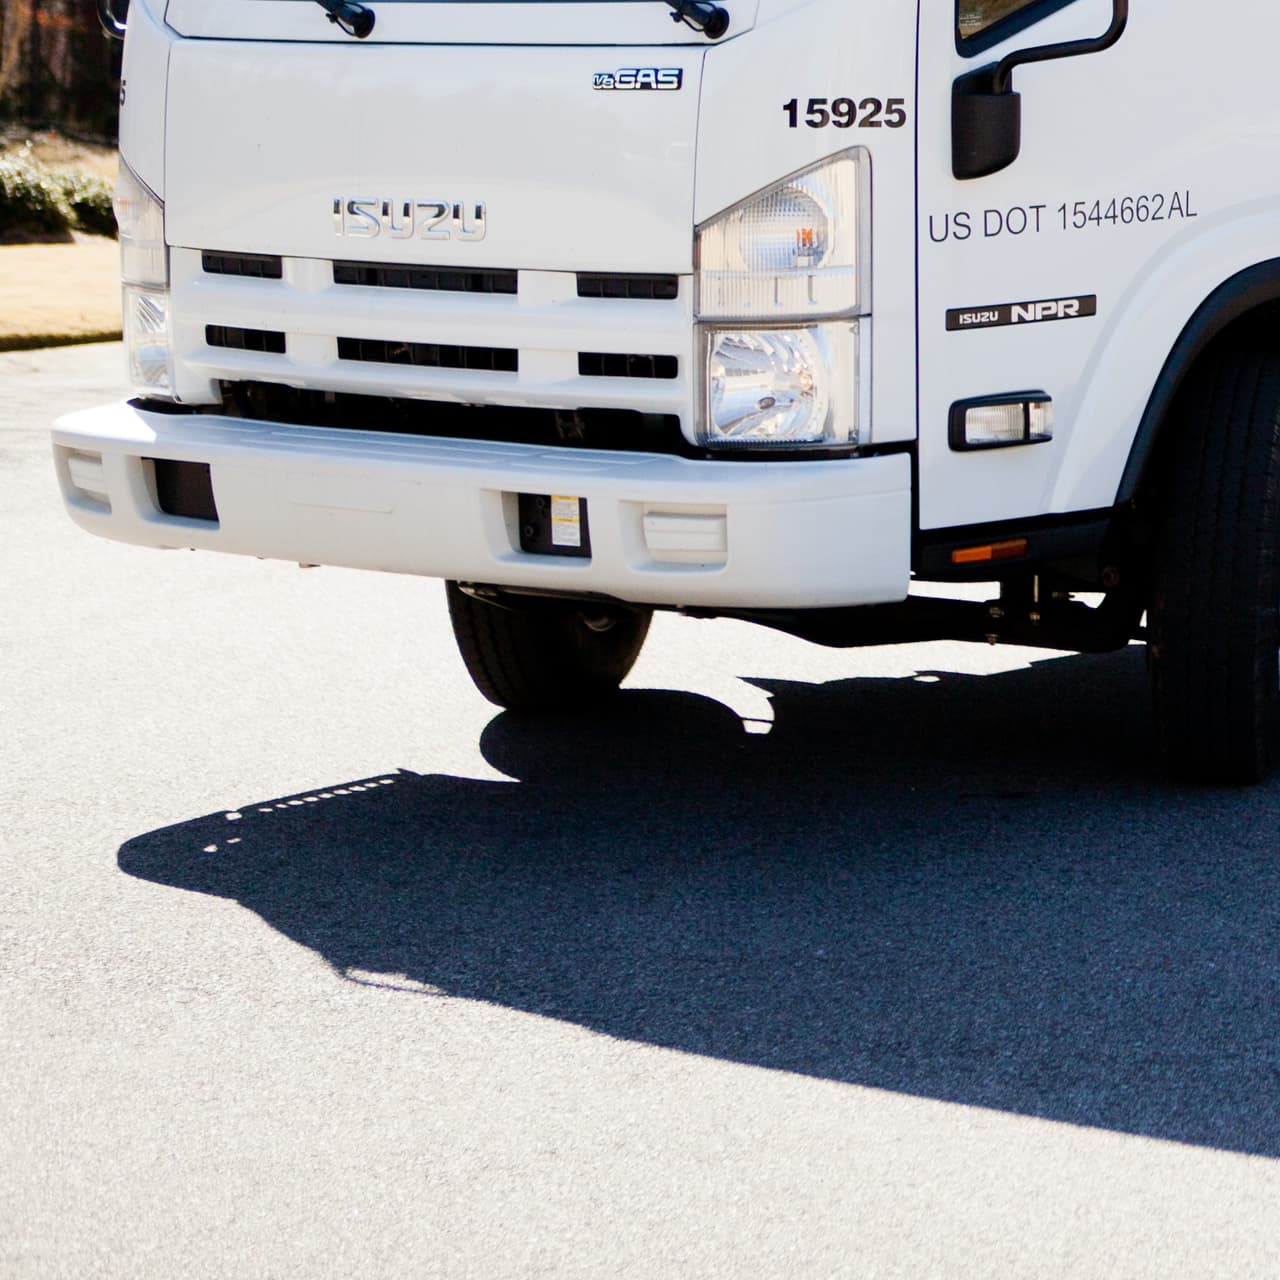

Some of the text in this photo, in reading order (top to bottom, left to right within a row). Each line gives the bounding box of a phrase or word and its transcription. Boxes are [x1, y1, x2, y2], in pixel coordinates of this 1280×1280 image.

[615, 67, 680, 89] GAS
[782, 97, 907, 129] 15925
[333, 196, 487, 241] ISUZU
[929, 190, 1198, 243] US DOT 1544662AL
[958, 298, 1080, 325] ISUZU NPR
